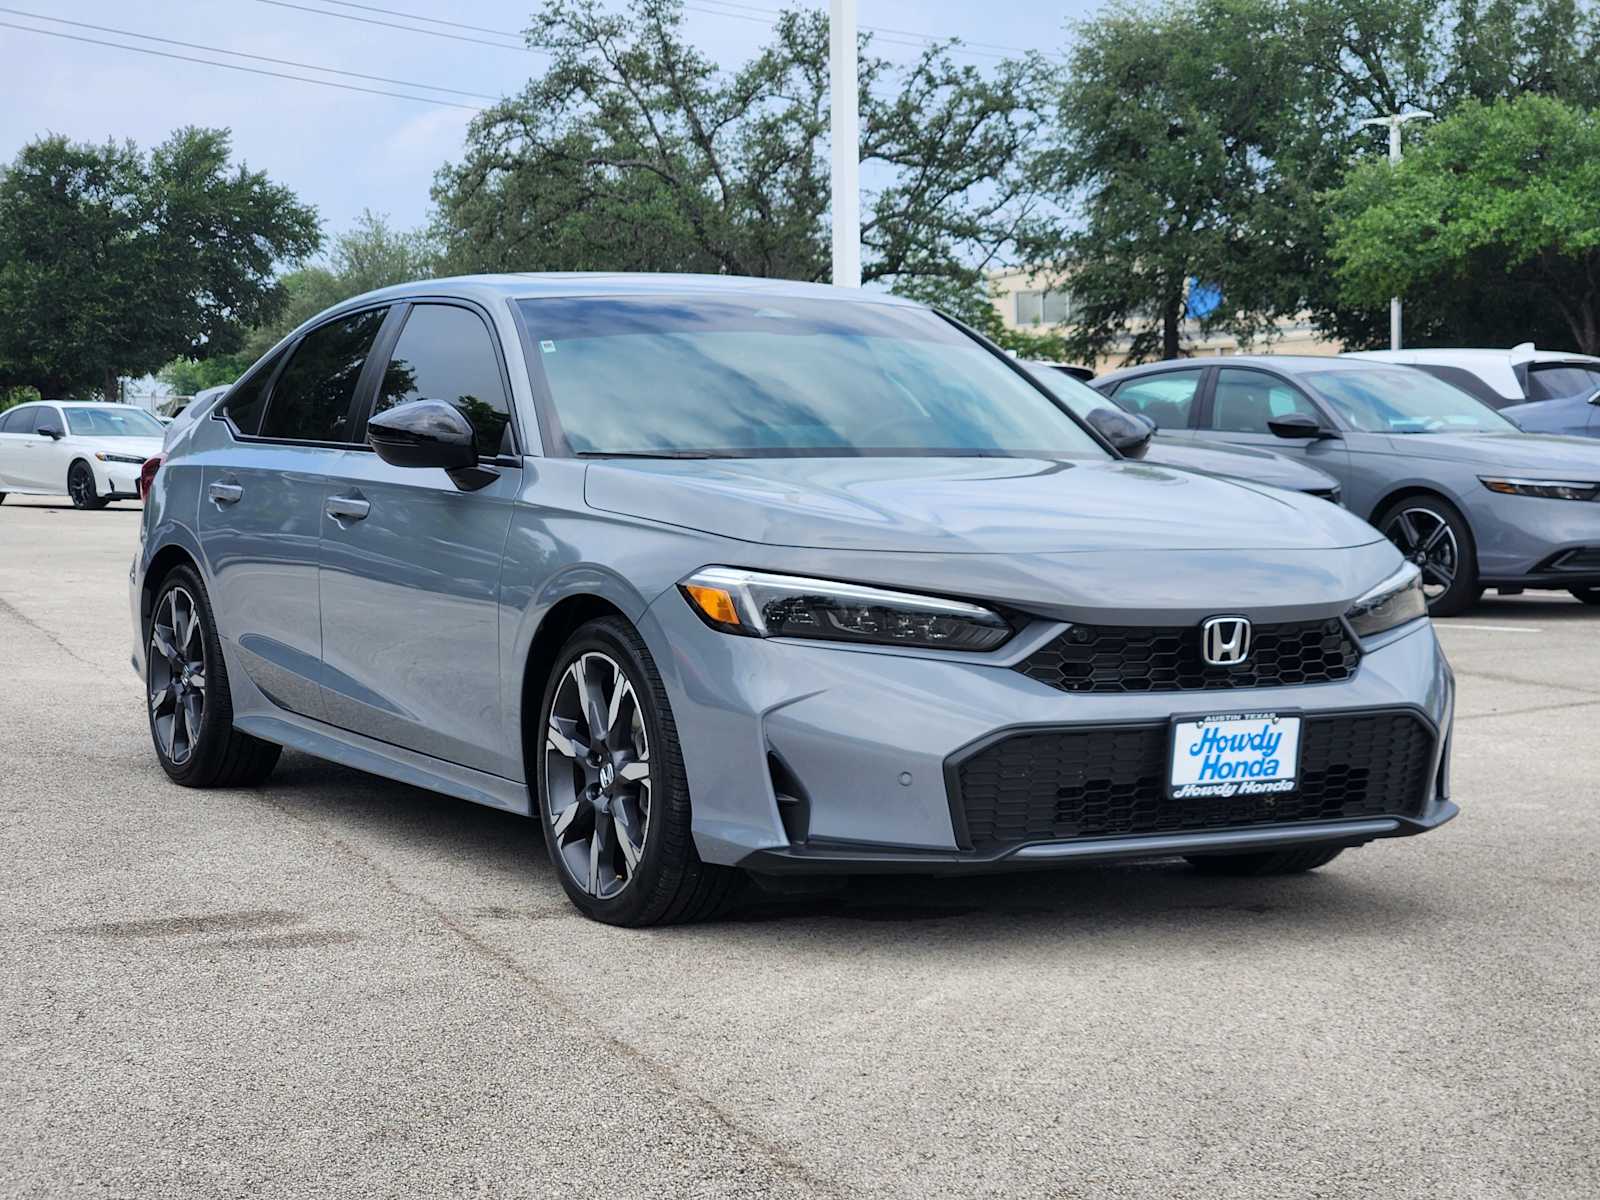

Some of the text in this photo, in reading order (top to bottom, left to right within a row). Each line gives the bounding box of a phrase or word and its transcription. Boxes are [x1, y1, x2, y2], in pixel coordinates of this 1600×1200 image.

[1204, 712, 1276, 723] AUSTIN TEXAS
[1189, 724, 1283, 757] Howdy
[1198, 754, 1280, 781] Honda
[1174, 780, 1294, 798] Howdy Honda
